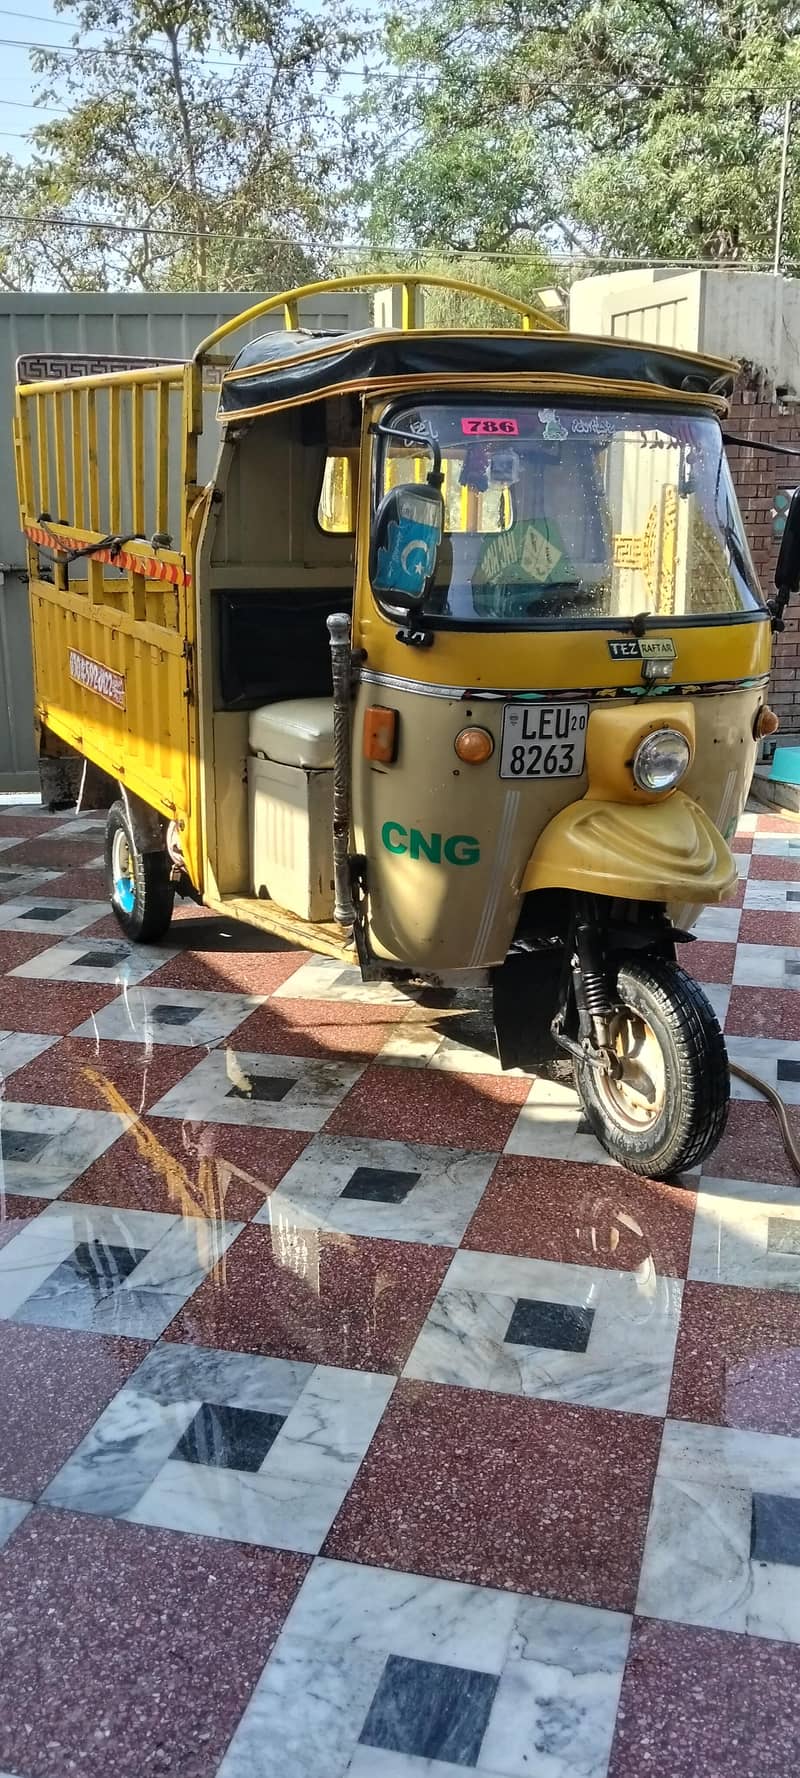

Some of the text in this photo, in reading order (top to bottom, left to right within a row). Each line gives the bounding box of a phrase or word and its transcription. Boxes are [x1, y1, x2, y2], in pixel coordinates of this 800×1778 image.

[468, 421, 515, 433] 786
[610, 643, 673, 655] TEZ RAFTAR
[522, 708, 570, 740] LEU
[571, 715, 585, 731] 20
[510, 744, 575, 775] 8263
[381, 821, 480, 867] CNG
